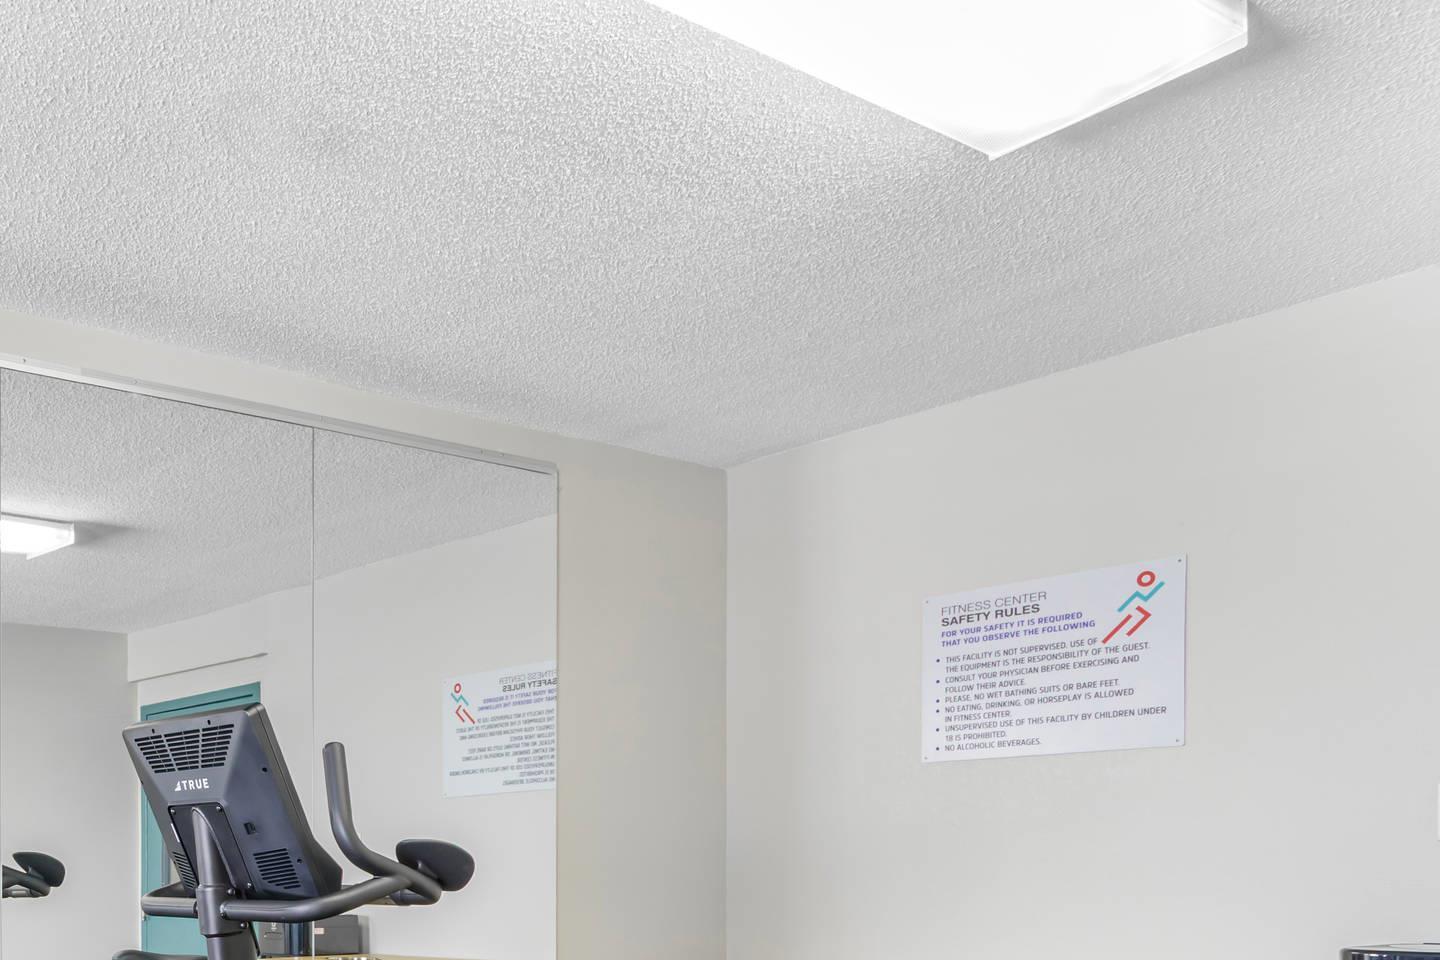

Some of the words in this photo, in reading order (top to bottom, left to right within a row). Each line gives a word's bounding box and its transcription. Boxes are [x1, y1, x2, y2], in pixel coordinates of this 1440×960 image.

[941, 611, 990, 627] SAFETY
[995, 603, 1040, 619] RULES
[942, 600, 991, 616] FITNESS
[994, 591, 1047, 608] CENTER
[942, 630, 957, 638] FOR
[960, 626, 981, 635] YOUR
[984, 621, 1014, 632] SAFETY
[1017, 620, 1024, 628] IT
[1028, 618, 1035, 626] IS
[1038, 611, 1083, 625] REQUIRED
[942, 638, 960, 648] THAT
[964, 636, 980, 644] YOU
[982, 630, 1020, 642] OBSERVE
[1023, 627, 1039, 636] THE
[1042, 620, 1096, 634] FOLLOWING
[946, 665, 959, 673] THE
[960, 660, 1000, 672] EQUIPMENT
[1012, 657, 1025, 665] THE
[1027, 649, 1089, 663] RESPONSIBILITY
[1091, 647, 1102, 656] OF
[1105, 645, 1119, 654] THE
[963, 651, 992, 661] FACILITY
[1003, 648, 1018, 656] NOT
[1070, 639, 1085, 648] USE
[1088, 637, 1098, 646] OF
[945, 674, 975, 684] CONSULT
[977, 671, 997, 680] YOUR
[999, 666, 1039, 677] PHYSICIAN
[1041, 662, 1071, 673] BEFORE
[1073, 657, 1119, 669] EXERCISING
[1121, 654, 1140, 663] AND
[945, 684, 975, 693] FOLLOW
[976, 682, 996, 690] THEIR
[987, 691, 1003, 699] WET
[1005, 687, 1037, 697] BATHING
[1040, 685, 1061, 694] SUITS
[1063, 683, 1074, 691] OR
[1076, 681, 1097, 690] BARE
[945, 705, 955, 713] NO
[1024, 698, 1035, 706] OR
[1037, 694, 1082, 704] HORSEPLAY
[1094, 688, 1134, 699] ALLOWED
[945, 722, 997, 732] UNSUPERVISED
[1000, 719, 1014, 727] USE
[1016, 718, 1025, 726] OF
[1028, 717, 1044, 725] THIS
[1046, 714, 1079, 723] FACILITY
[1094, 709, 1135, 720] CHILDREN
[1138, 706, 1167, 716] UNDER
[954, 713, 981, 722] FITNESS
[956, 742, 995, 750] ALCOHOLIC
[181, 778, 209, 790] TRUE
